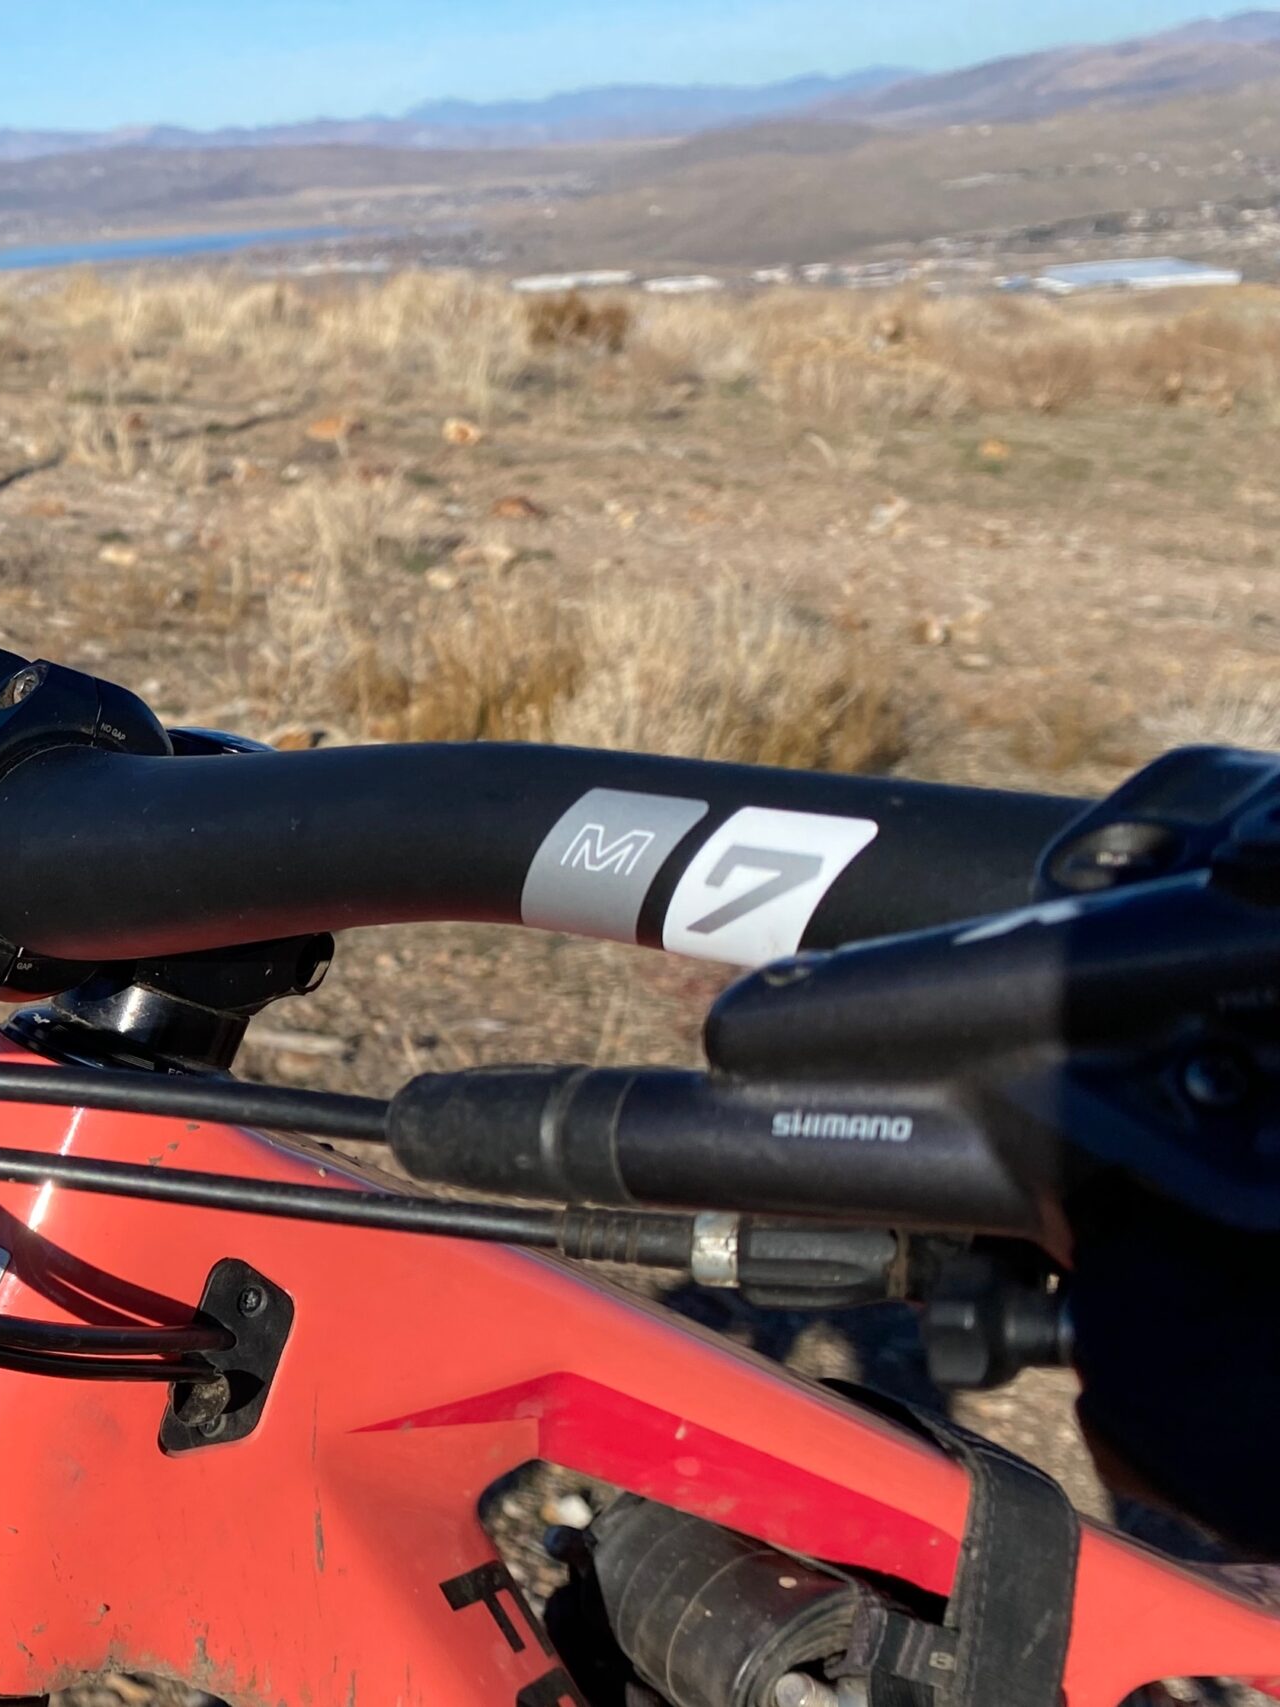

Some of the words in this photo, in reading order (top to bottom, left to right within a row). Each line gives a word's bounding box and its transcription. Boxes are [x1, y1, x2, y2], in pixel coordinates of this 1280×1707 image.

[100, 722, 112, 733] NO
[111, 728, 127, 741] GAP
[560, 823, 655, 876] M
[686, 844, 824, 935] 7
[16, 962, 33, 970] GAP
[771, 1109, 914, 1142] SHIMANO
